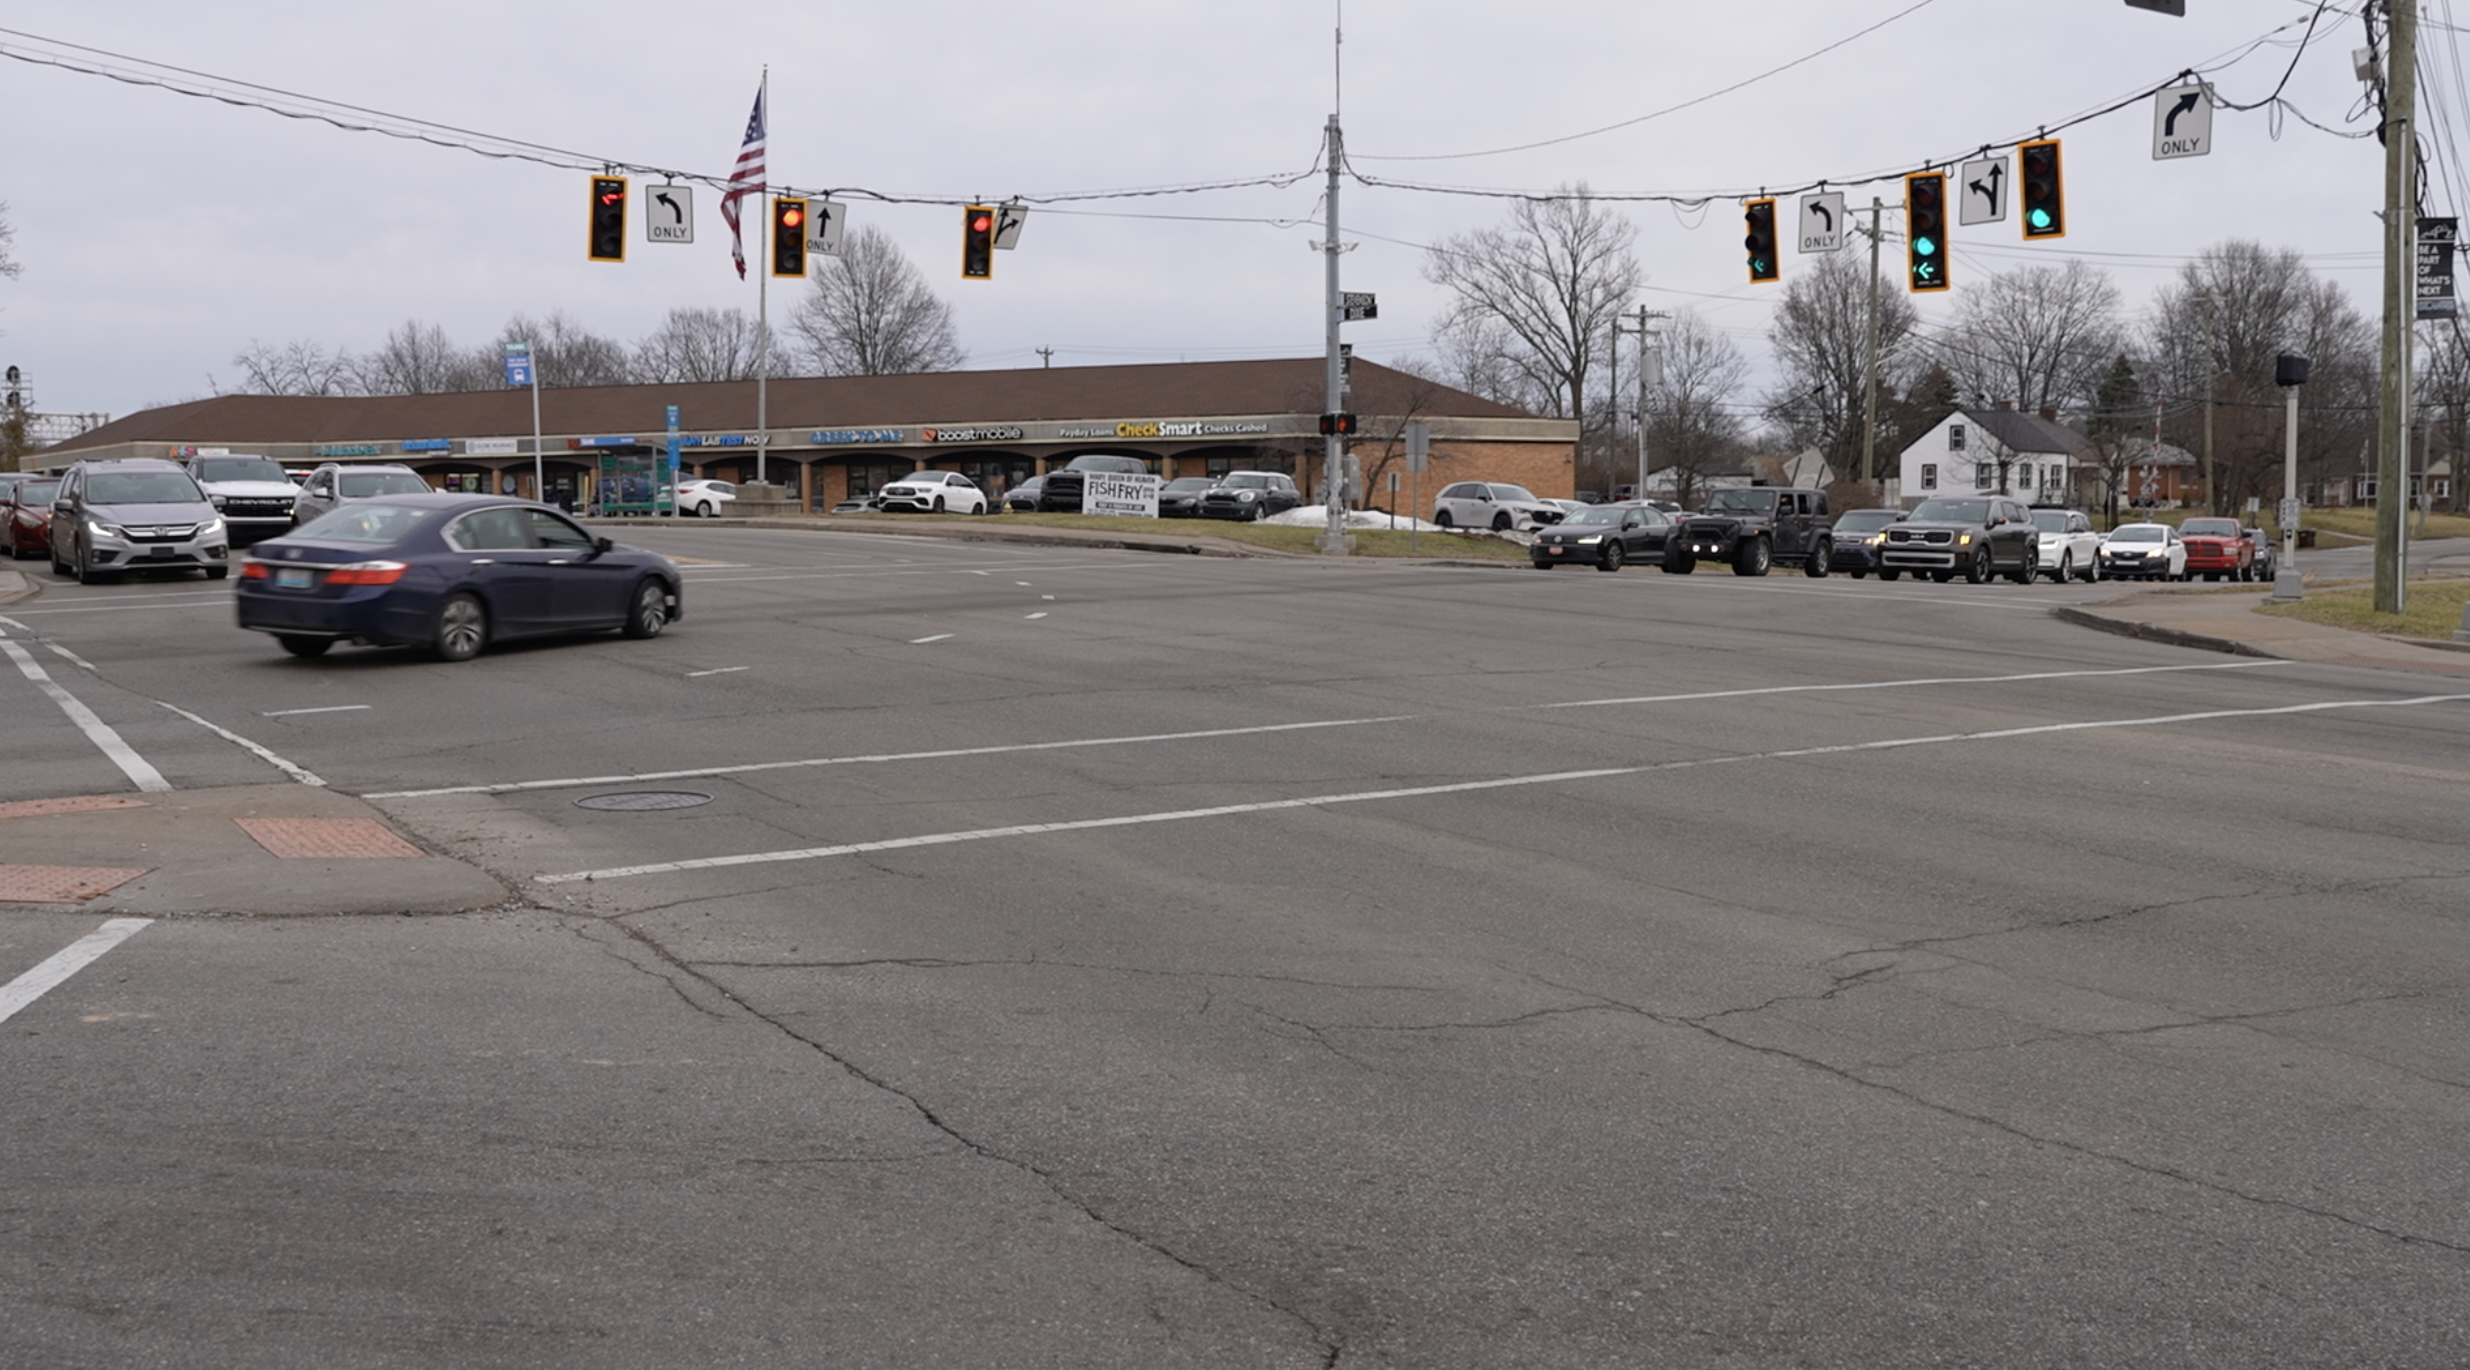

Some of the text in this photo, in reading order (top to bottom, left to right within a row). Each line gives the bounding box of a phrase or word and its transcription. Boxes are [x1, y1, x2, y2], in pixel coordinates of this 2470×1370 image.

[2161, 138, 2200, 155] ONLY
[654, 226, 688, 238] ONLY
[806, 240, 834, 252] ONLY
[1805, 235, 1837, 249] ONLY
[2419, 245, 2439, 255] BE A
[2419, 255, 2441, 265] PART
[2418, 265, 2431, 275] OF
[2419, 275, 2451, 285] WHAT'S
[2419, 285, 2441, 295] NEXT
[1059, 421, 1268, 438] Payday Loans CheckSmart Checks Cashed
[1088, 481, 1143, 500] FISH FRY
